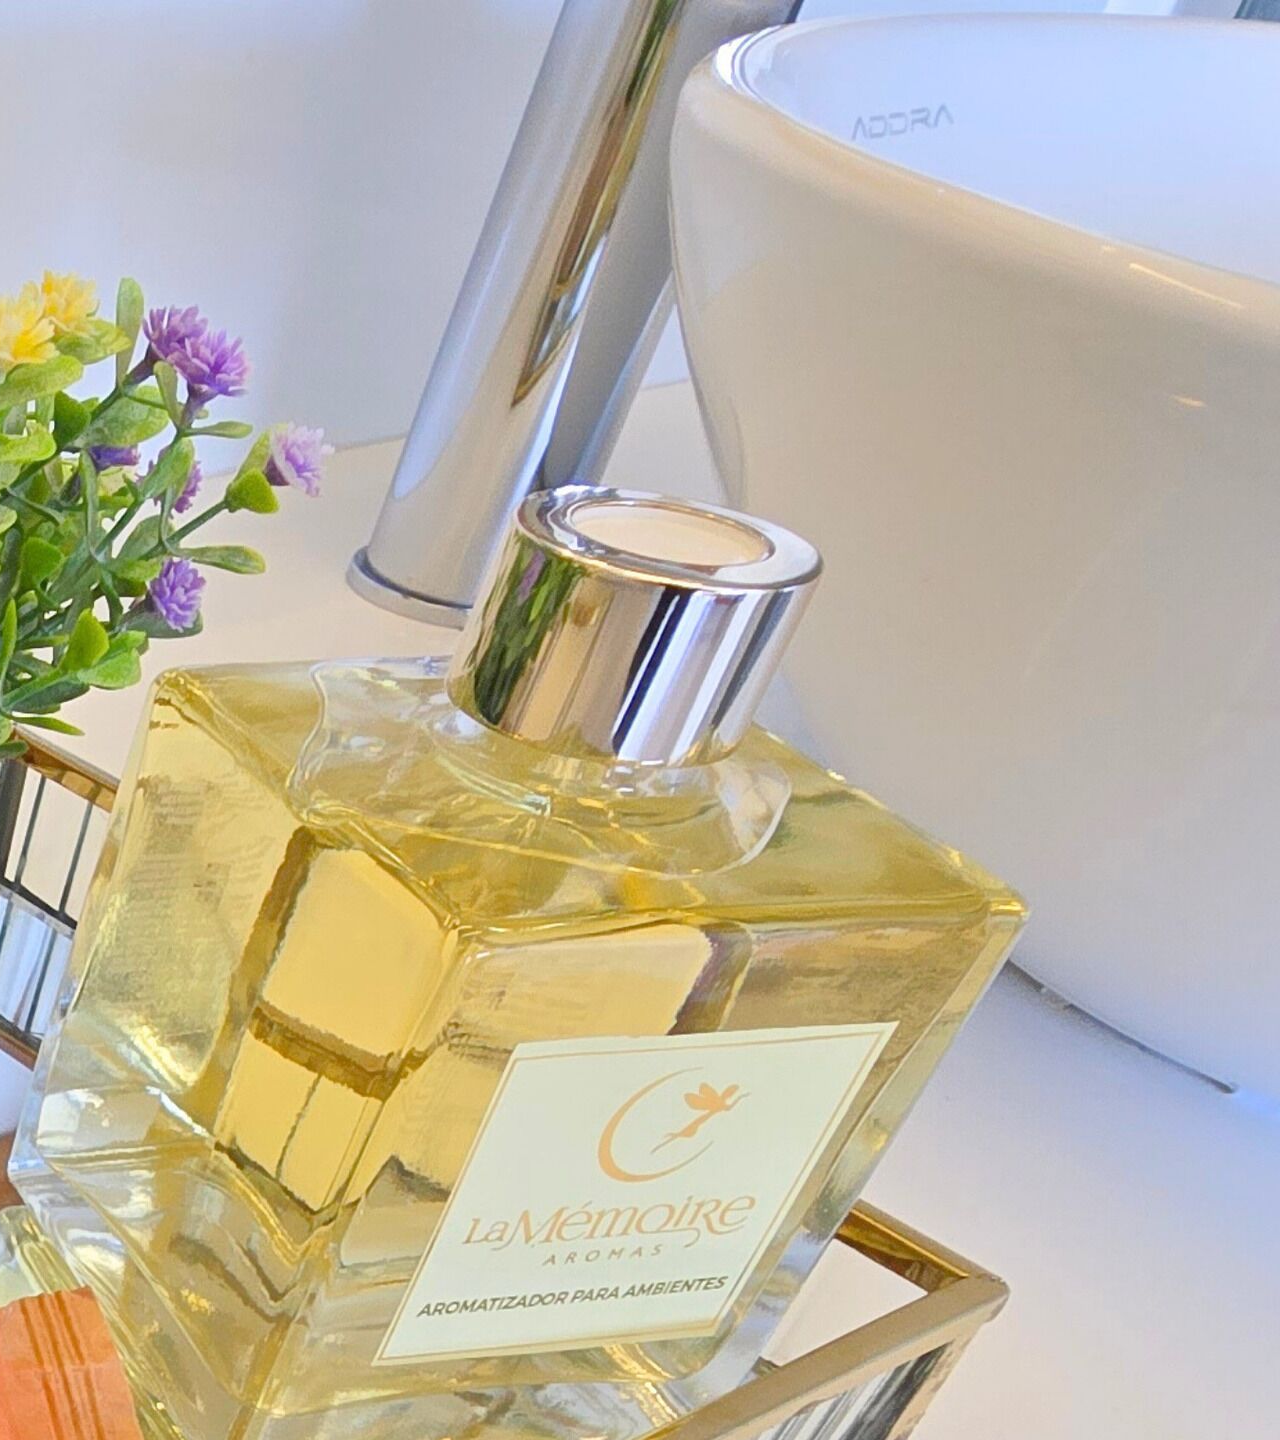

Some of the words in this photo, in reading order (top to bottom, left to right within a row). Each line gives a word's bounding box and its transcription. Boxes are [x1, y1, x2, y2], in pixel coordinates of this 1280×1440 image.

[851, 104, 955, 141] ADORA
[542, 1244, 663, 1267] AROMAS
[417, 1290, 569, 1318] AROMATIZADOR
[570, 1285, 620, 1304] PARA
[622, 1275, 729, 1299] AMBIENTES
